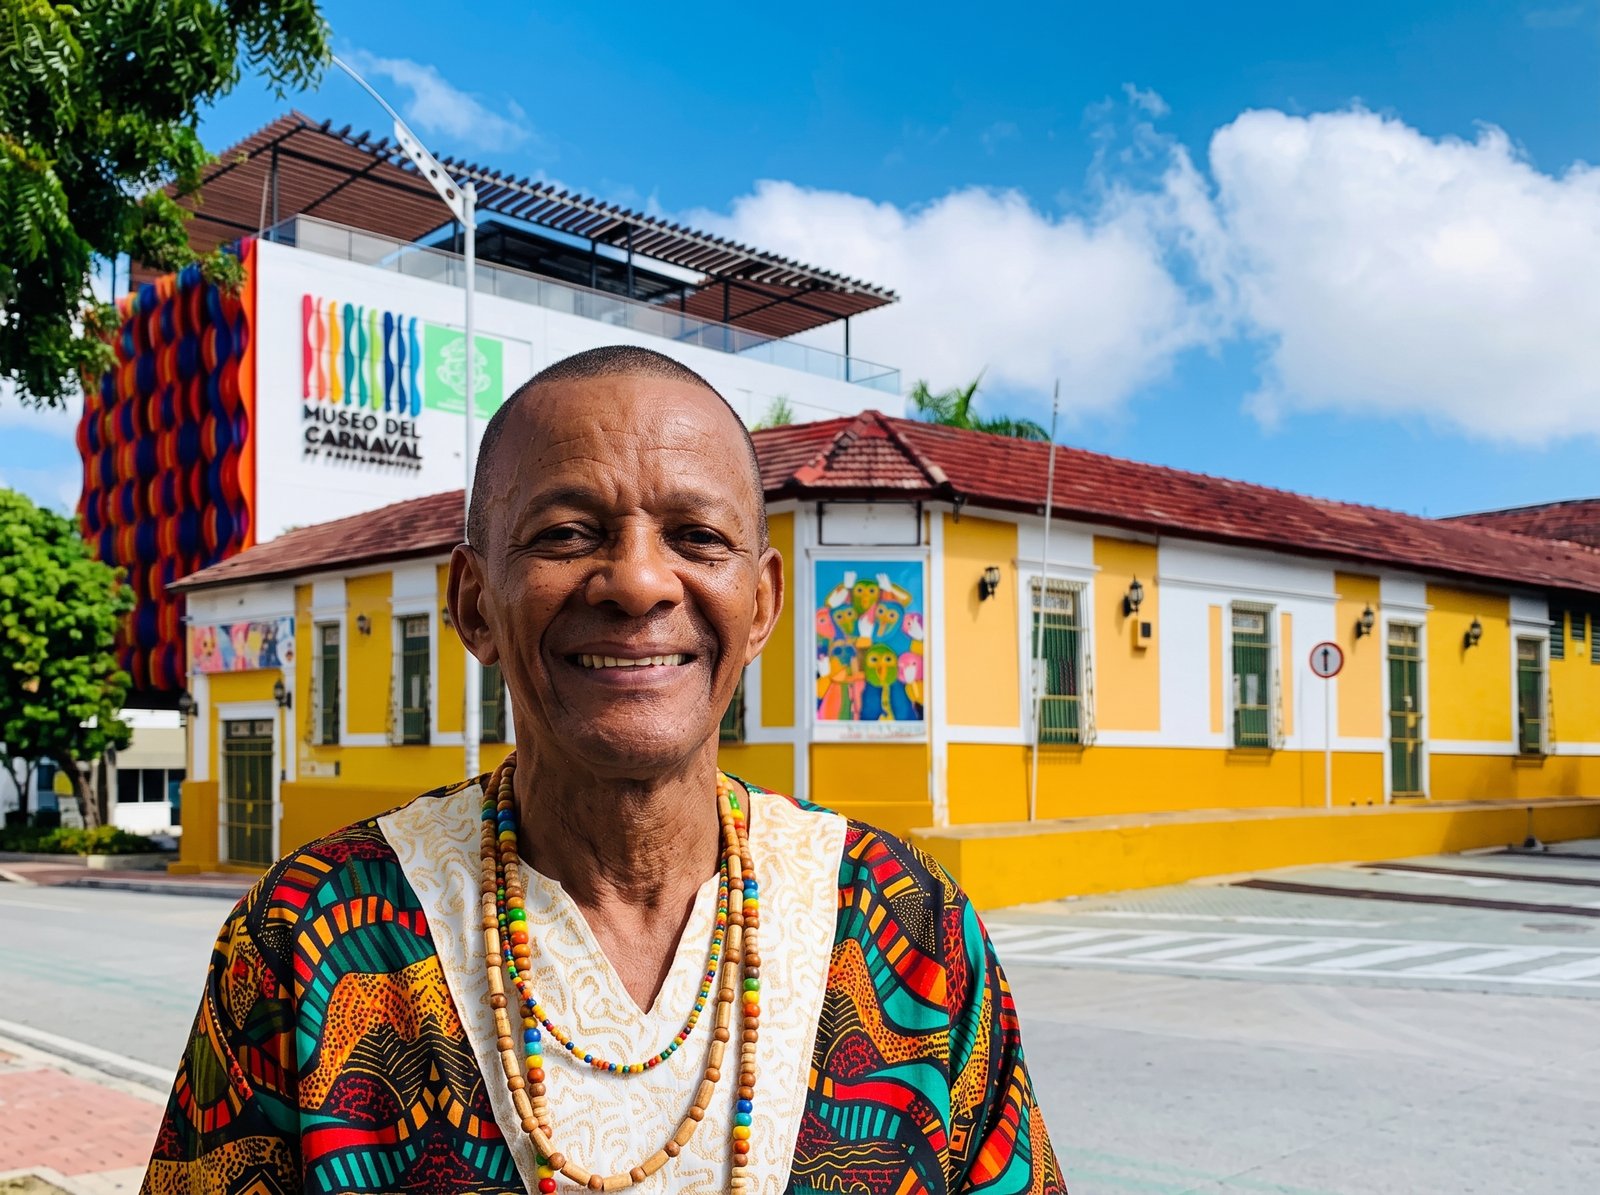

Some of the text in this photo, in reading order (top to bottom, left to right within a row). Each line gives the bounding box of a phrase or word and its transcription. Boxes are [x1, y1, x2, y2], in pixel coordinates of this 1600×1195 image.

[304, 404, 421, 439] MUSEO DEL
[305, 426, 423, 460] CARNAVAL
